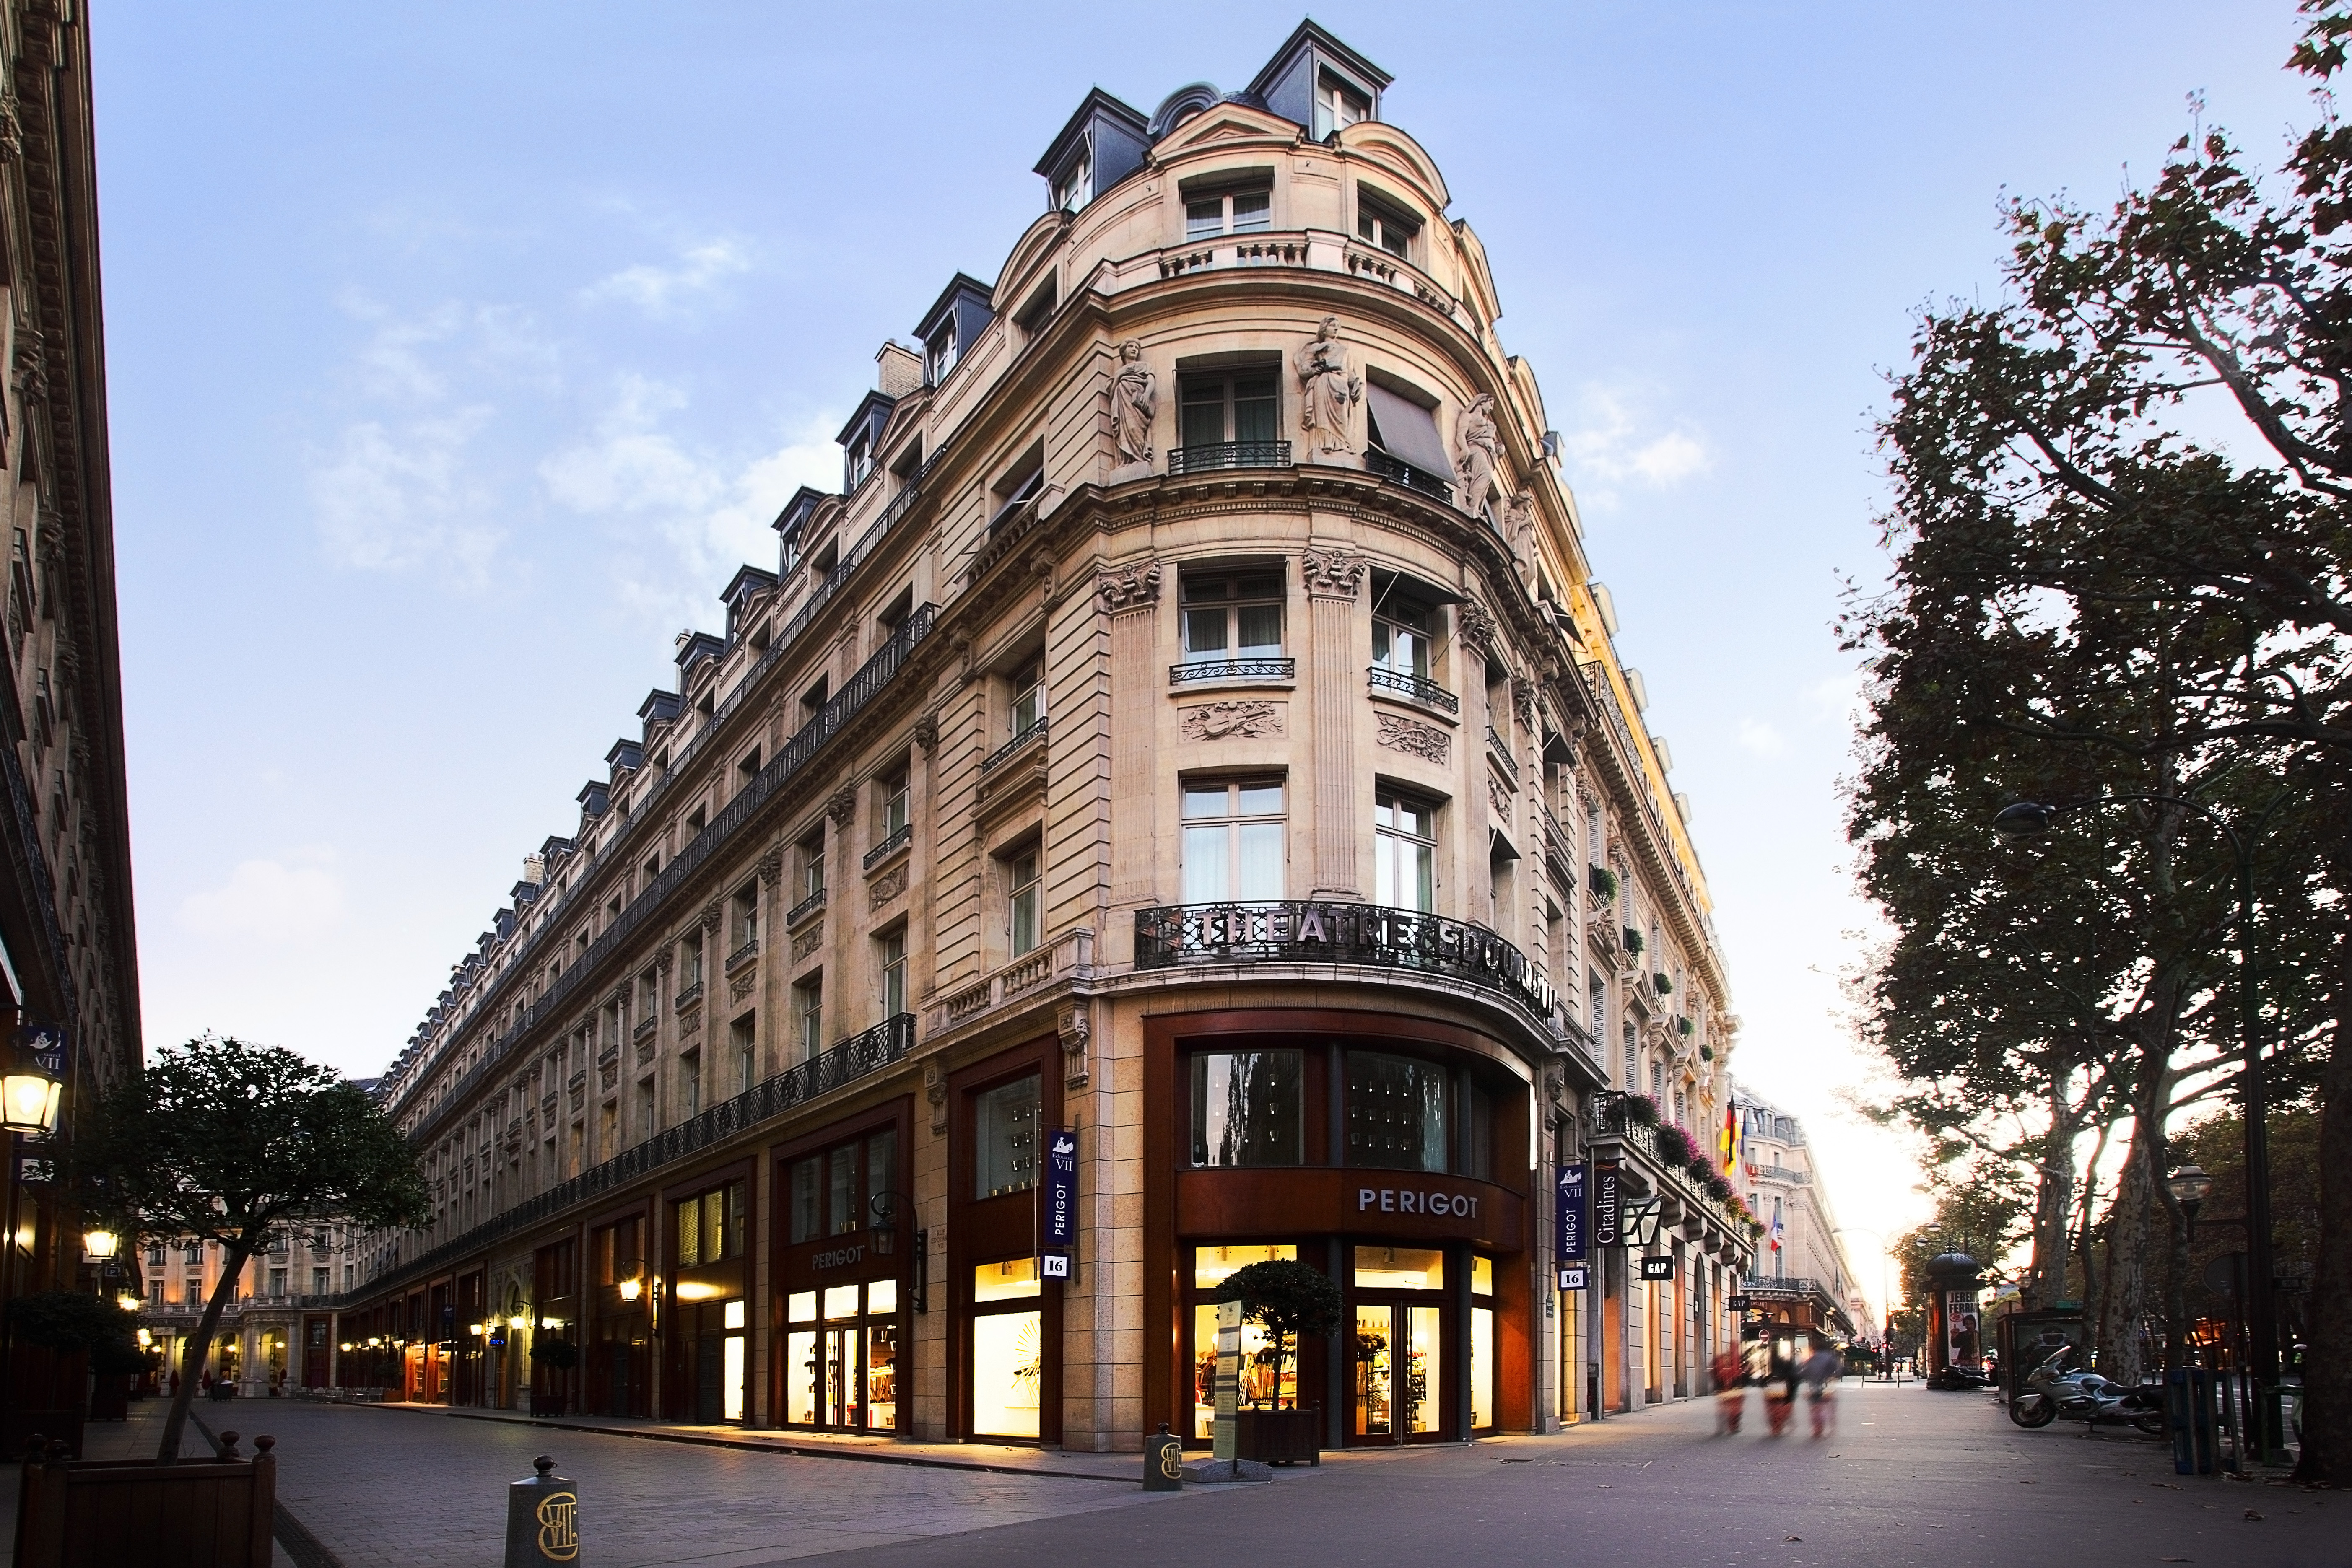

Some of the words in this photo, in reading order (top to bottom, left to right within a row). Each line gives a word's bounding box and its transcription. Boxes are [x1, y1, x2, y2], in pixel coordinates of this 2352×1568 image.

[1195, 908, 1414, 949] THEATRE
[36, 1057, 60, 1069] VII
[1052, 1151, 1073, 1161] Édouard
[1056, 1159, 1072, 1171] VII
[1564, 1188, 1582, 1197] VII
[1359, 1189, 1477, 1218] PERIGOT
[1597, 1176, 1615, 1243] Citadines
[1054, 1184, 1066, 1236] PERIGOT
[1566, 1208, 1576, 1252] PERIGOT
[812, 1245, 863, 1270] PERIGOT
[1049, 1260, 1063, 1272] 16
[1648, 1262, 1667, 1274] GAP
[1565, 1274, 1579, 1284] 16
